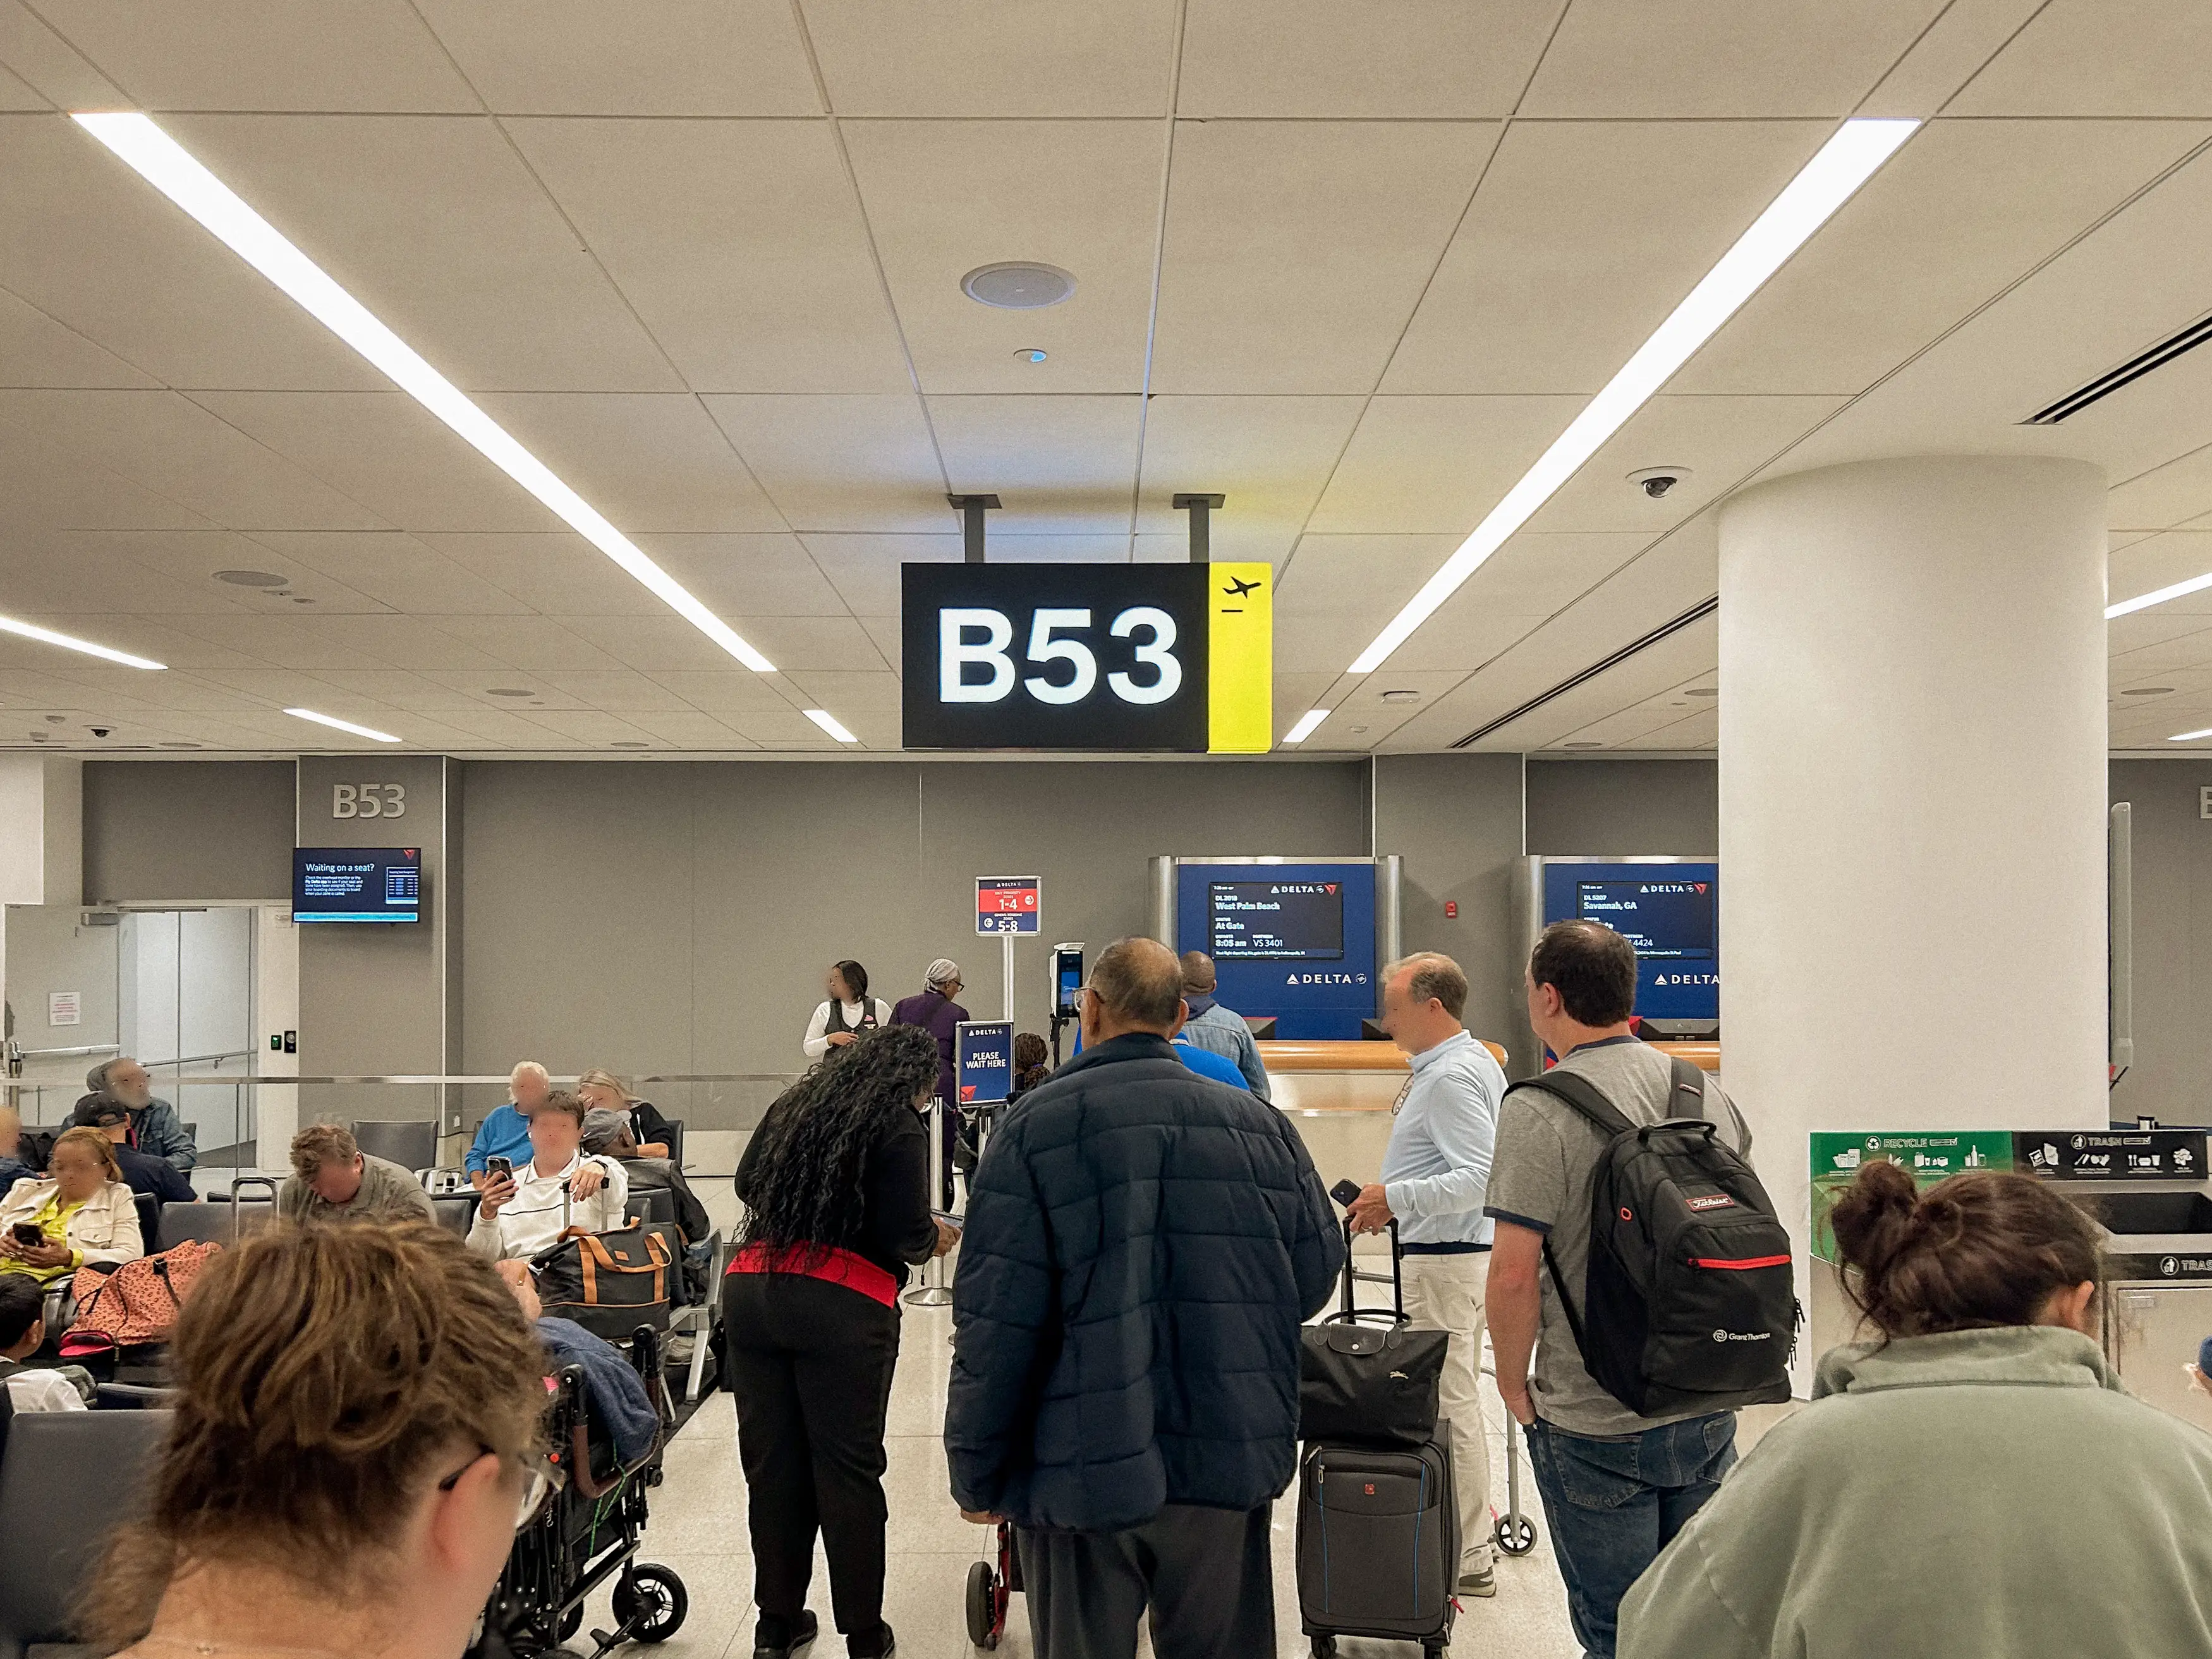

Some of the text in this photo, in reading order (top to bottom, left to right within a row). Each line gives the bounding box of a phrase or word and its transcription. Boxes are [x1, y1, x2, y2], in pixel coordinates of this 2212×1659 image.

[939, 606, 1182, 705] B53
[333, 784, 406, 818] B53
[305, 863, 336, 873] Waiting
[355, 863, 375, 872] seat?
[999, 899, 1018, 910] 1-4
[1583, 901, 1638, 910] Savannah, GA
[998, 920, 1018, 932] 5-8
[1303, 974, 1352, 983] DELTA
[1672, 975, 1720, 984] DELTA
[973, 1052, 999, 1060] PLEASE
[966, 1059, 1006, 1069] WAIT HERE
[1883, 1138, 1928, 1148] RECYCLE
[2088, 1137, 2122, 1146] TRASH
